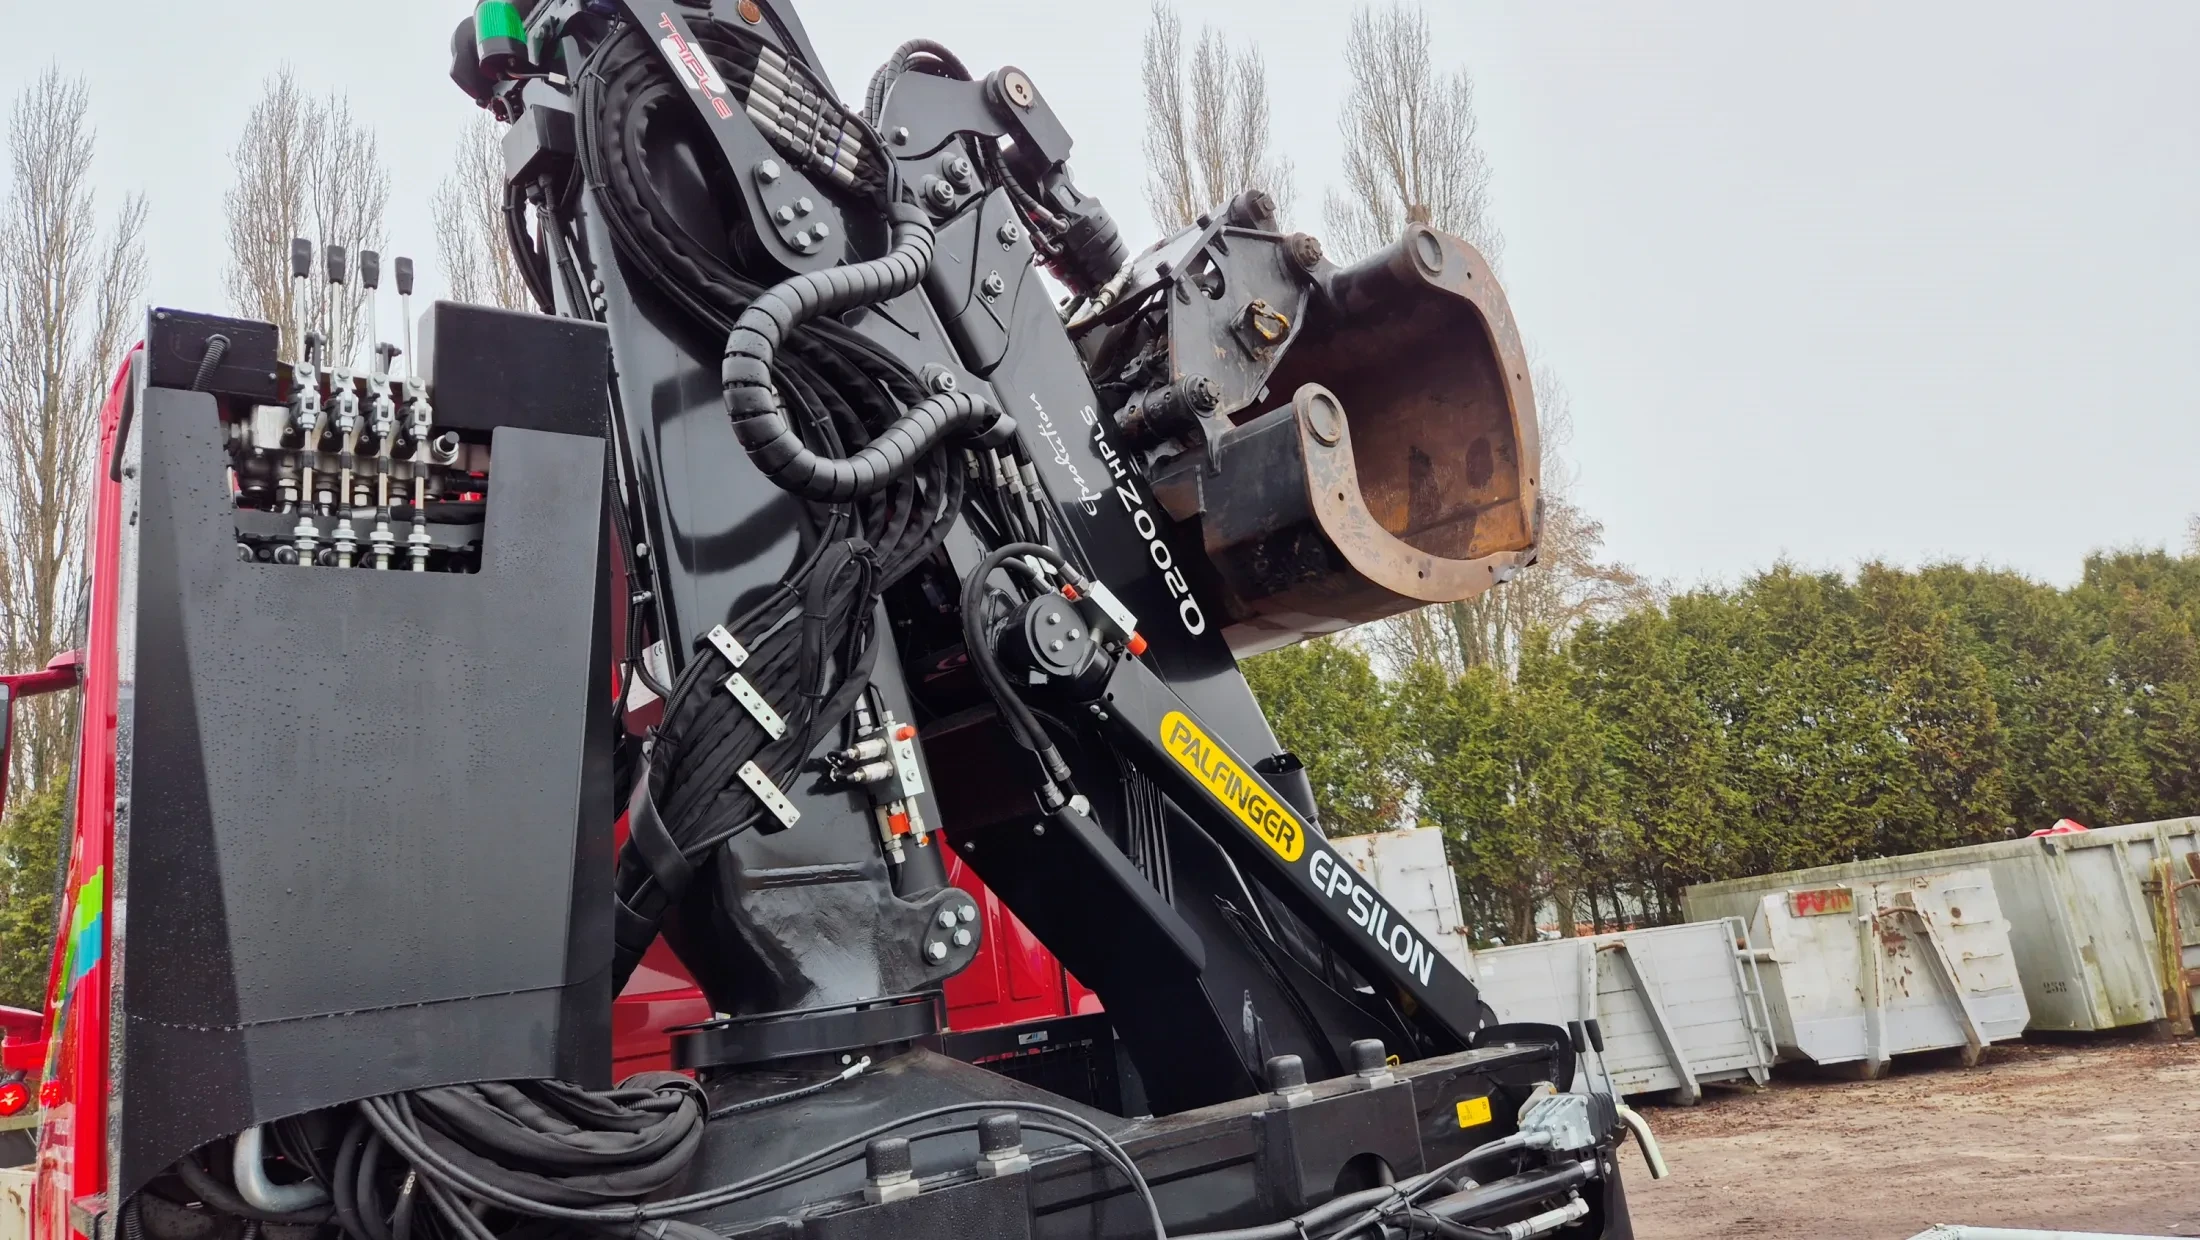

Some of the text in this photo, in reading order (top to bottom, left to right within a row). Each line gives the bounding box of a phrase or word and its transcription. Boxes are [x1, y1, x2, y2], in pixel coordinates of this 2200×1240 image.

[658, 12, 733, 119] TRIPLE
[1029, 392, 1102, 516] Epsolution
[1079, 404, 1127, 480] HPLS
[1169, 719, 1296, 853] PALFINGER
[1309, 850, 1434, 987] EPSILON
